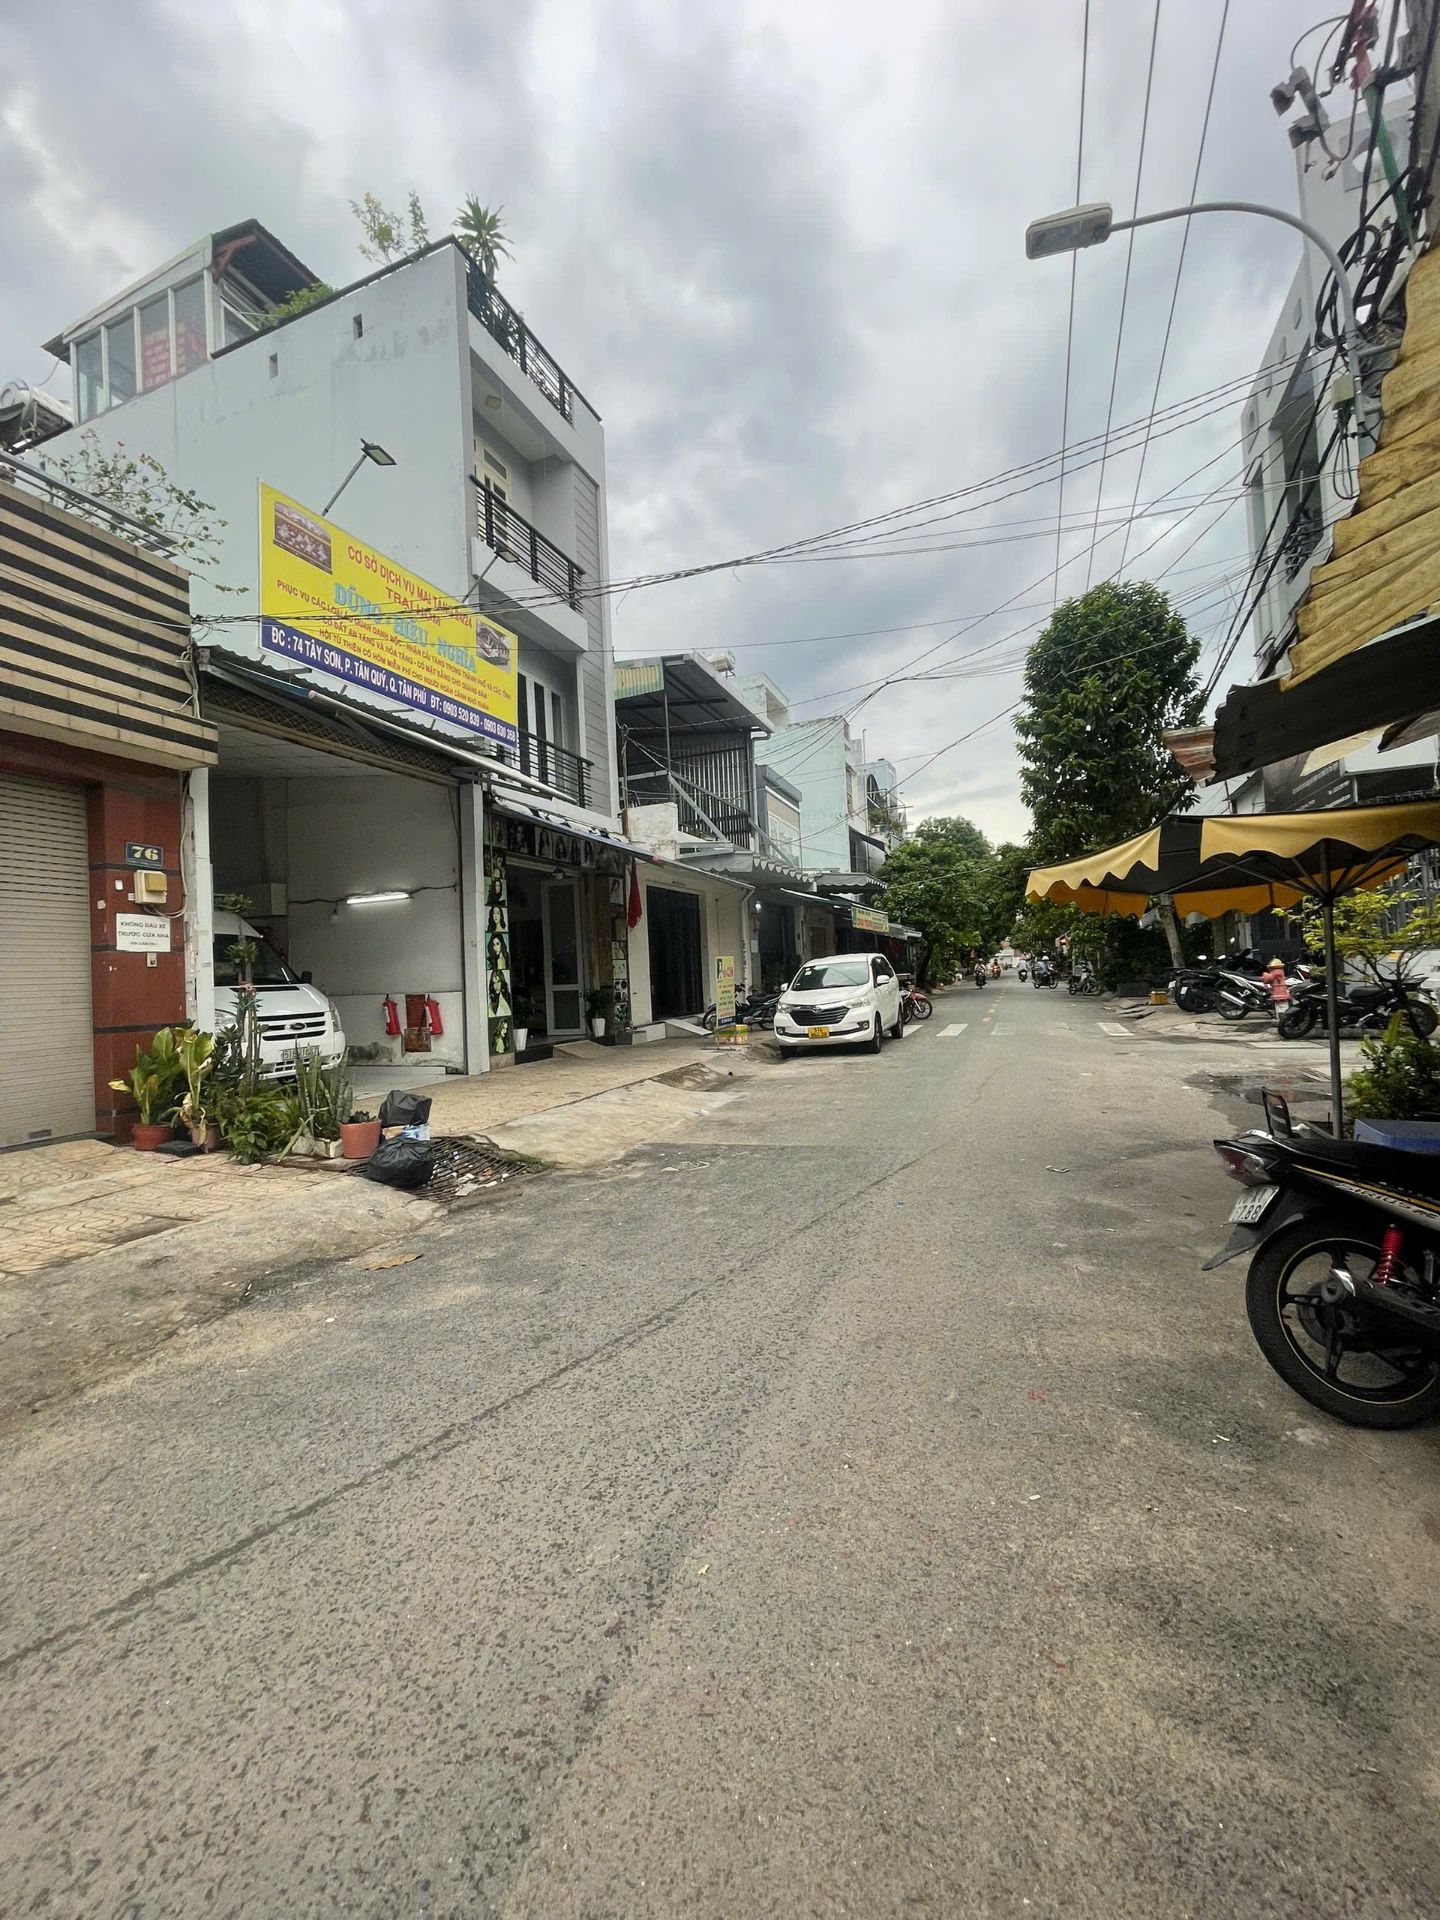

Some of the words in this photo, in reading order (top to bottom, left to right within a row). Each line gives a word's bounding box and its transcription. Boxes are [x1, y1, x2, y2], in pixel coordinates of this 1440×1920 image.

[348, 546, 362, 564] CƠ
[365, 556, 377, 573] SỞ
[381, 565, 400, 587] DỊCH
[404, 579, 414, 595] VỤ
[417, 587, 430, 604] MAI
[277, 580, 298, 596] PHỤC
[300, 591, 309, 602] VỤ
[312, 597, 326, 610] CÁC
[386, 587, 413, 611] TRẠI
[272, 627, 285, 646] ĐC
[294, 637, 303, 654] 74
[305, 641, 321, 661] TÂY
[324, 650, 343, 672] SƠN,
[346, 659, 352, 674] P.
[355, 661, 369, 681] TÂN
[372, 670, 388, 691] QUÝ,
[390, 678, 397, 693] Q.
[399, 681, 412, 699] TÂN
[413, 688, 426, 705] PHÚ
[431, 696, 442, 711] ĐT:
[443, 701, 457, 717] 0903
[458, 708, 468, 722] 520
[470, 713, 479, 727] 839
[484, 719, 496, 733] 0903
[132, 846, 159, 860] 76
